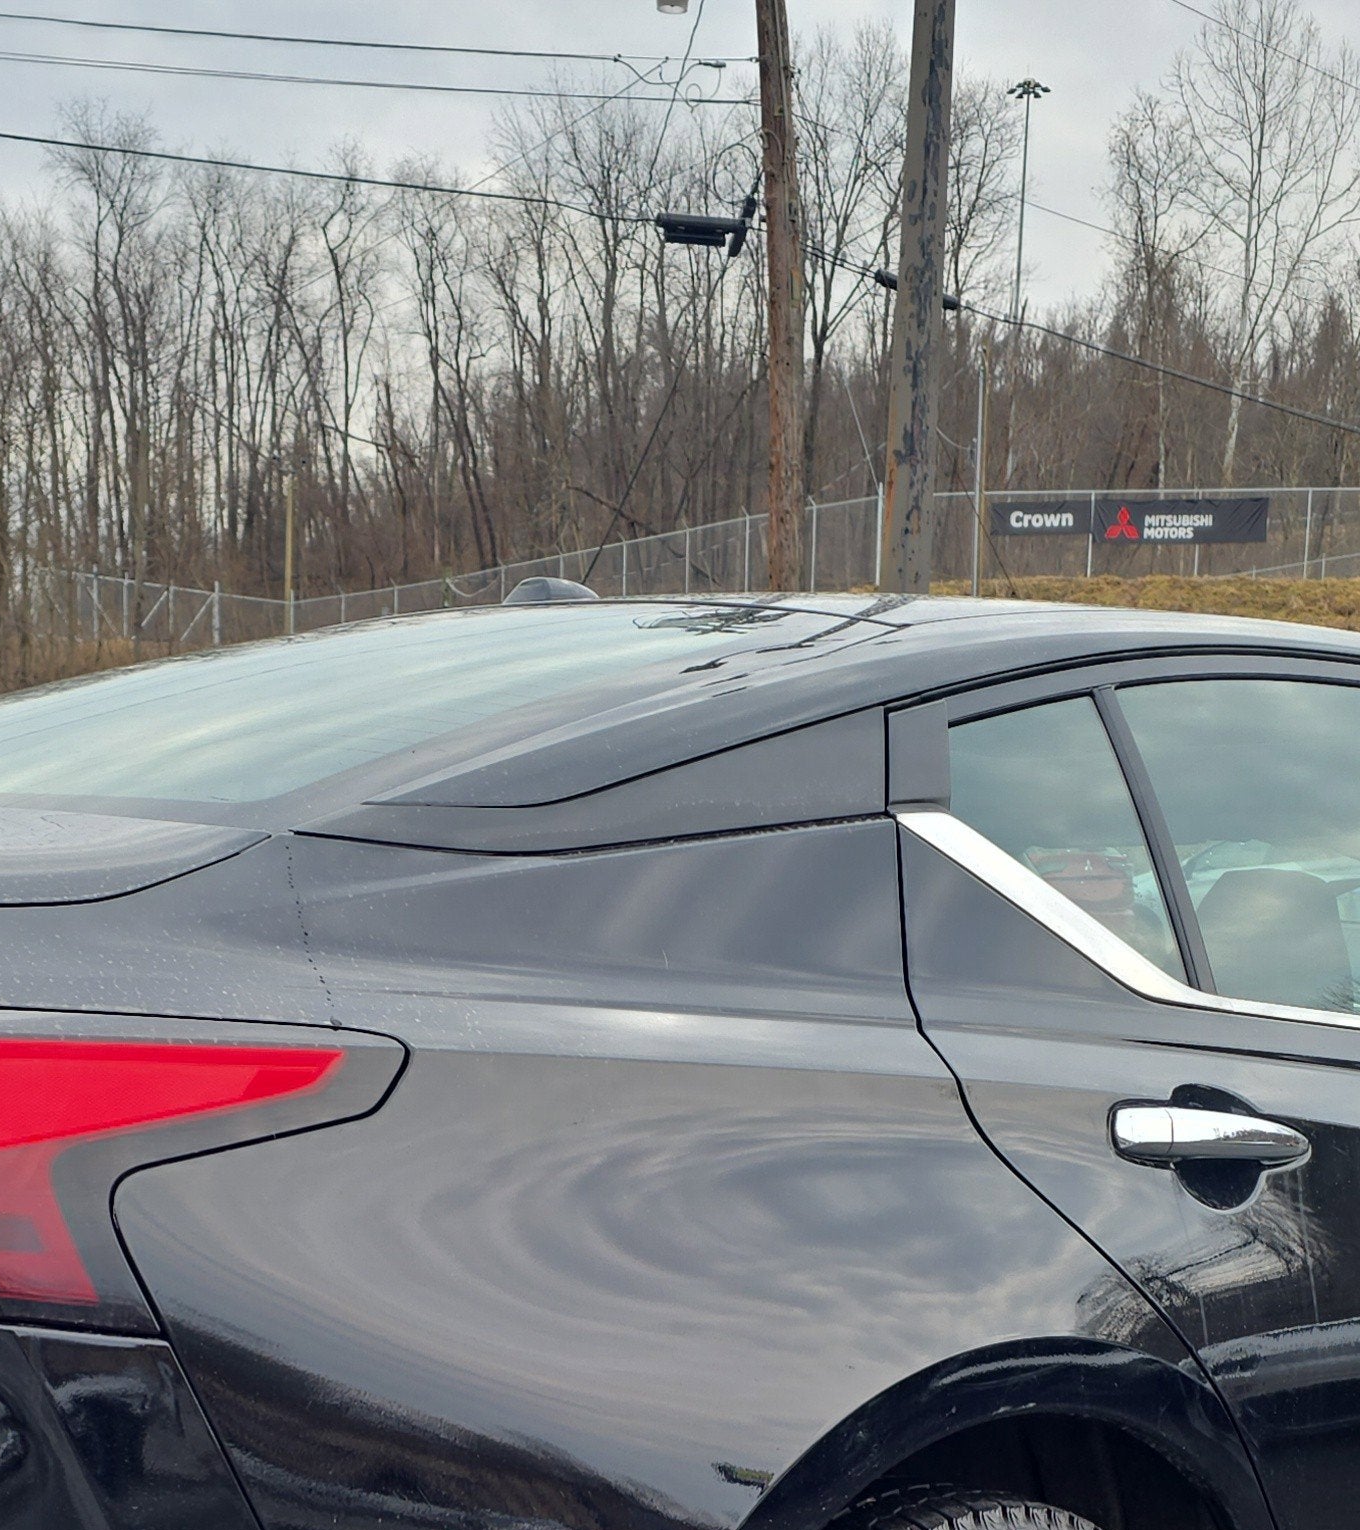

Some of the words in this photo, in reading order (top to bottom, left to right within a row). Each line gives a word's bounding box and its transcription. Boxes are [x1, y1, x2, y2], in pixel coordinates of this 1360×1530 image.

[1009, 510, 1074, 529] Crown
[1144, 513, 1214, 527] MITSUBISHI
[1143, 526, 1194, 540] MOTORS
